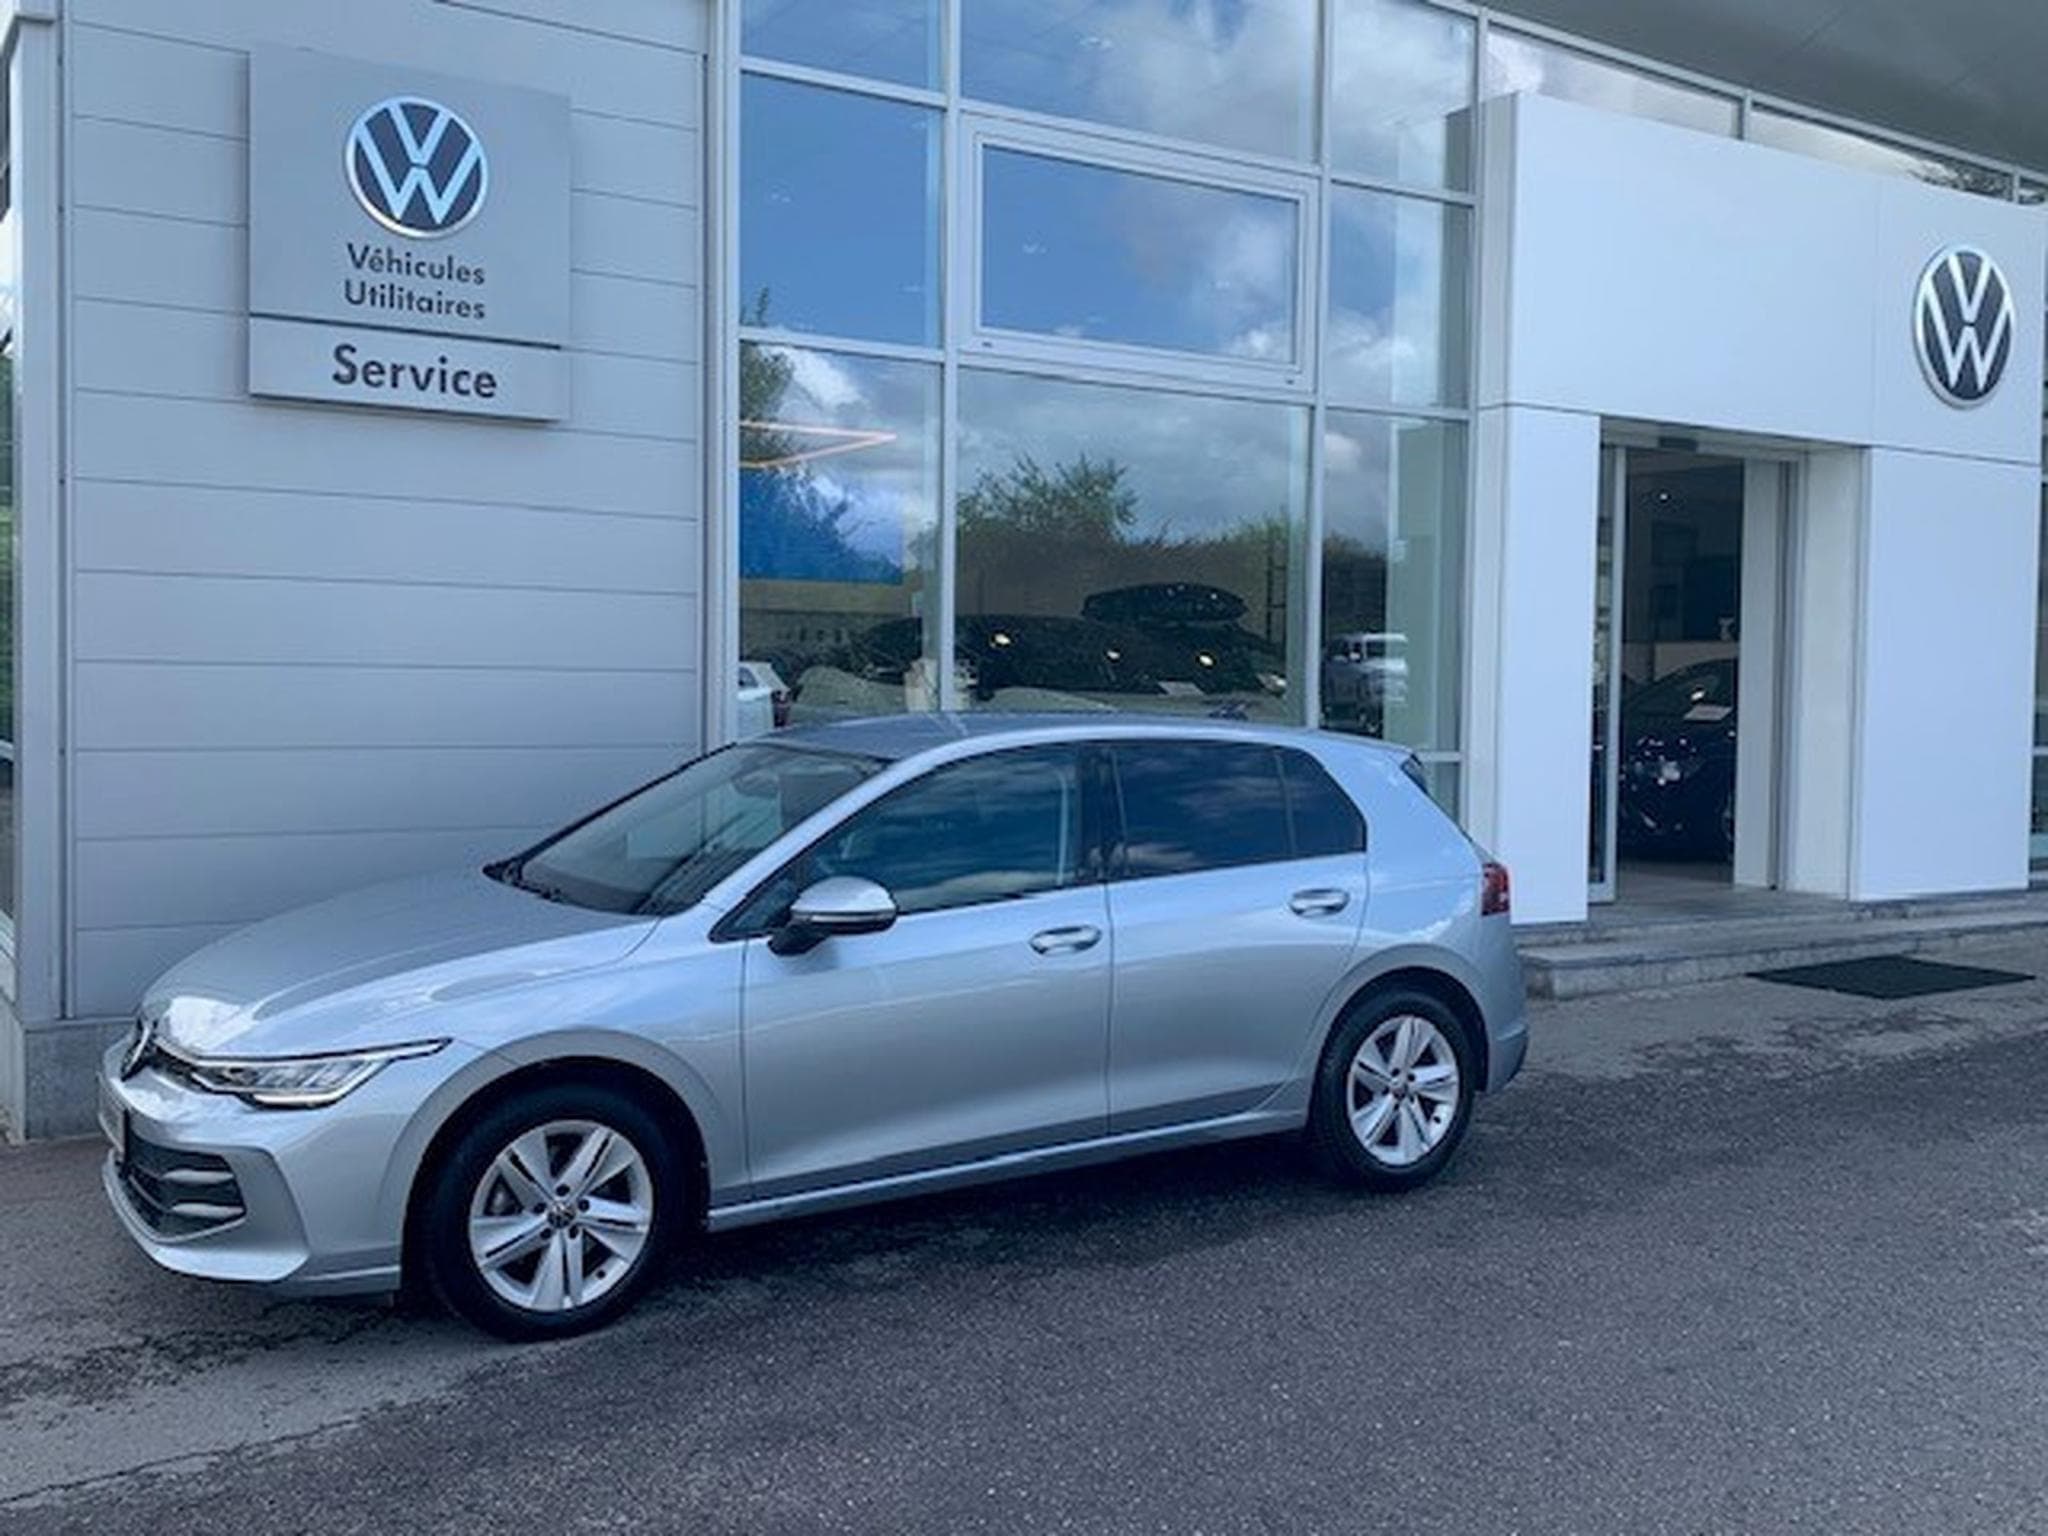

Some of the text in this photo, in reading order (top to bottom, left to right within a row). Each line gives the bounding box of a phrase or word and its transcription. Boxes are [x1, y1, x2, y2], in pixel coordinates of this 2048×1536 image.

[352, 99, 484, 226] VW
[346, 242, 486, 286] Véhicules
[344, 279, 486, 320] Utilitaires
[1919, 251, 2014, 392] VW
[332, 343, 498, 399] Service
